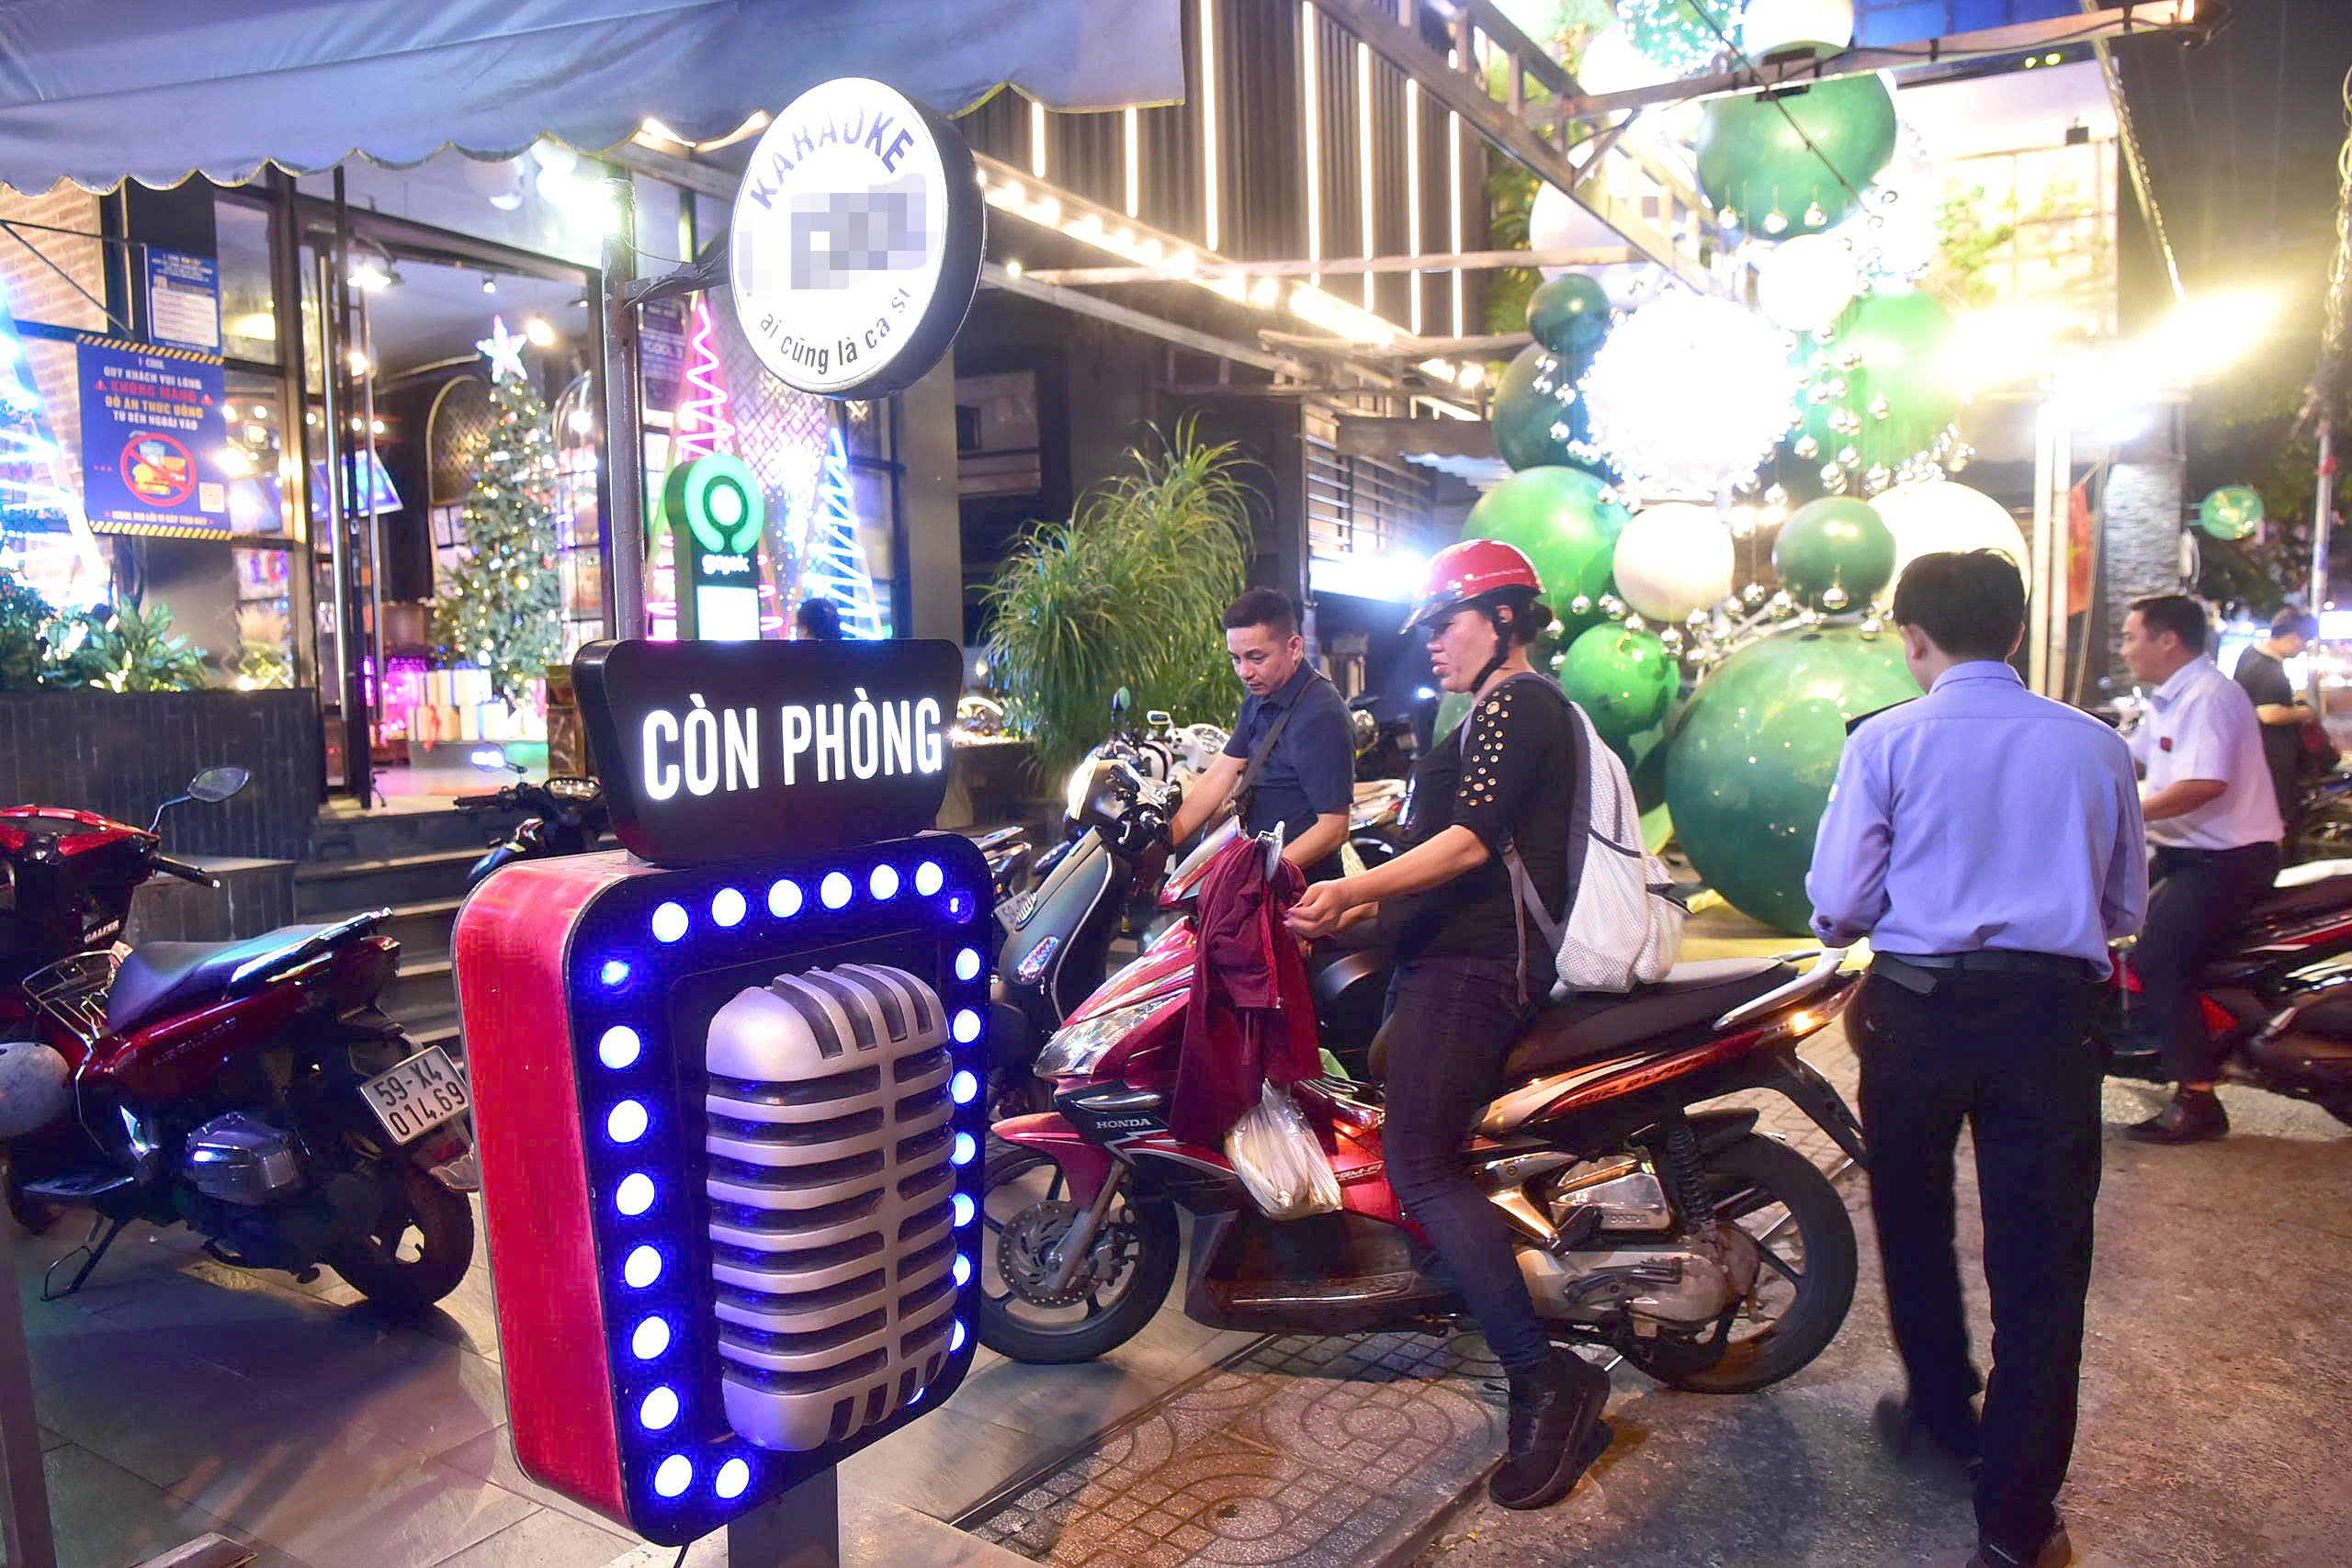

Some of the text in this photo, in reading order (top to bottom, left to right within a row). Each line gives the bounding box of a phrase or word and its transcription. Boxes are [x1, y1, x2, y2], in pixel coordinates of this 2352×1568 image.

[760, 313, 783, 339] ai
[837, 336, 858, 367] là
[865, 317, 891, 350] ca
[641, 687, 944, 801] CÒN PHÒNG
[373, 1058, 443, 1107] 59-X4
[389, 1080, 466, 1135] 014.69
[1095, 1118, 1154, 1129] HONDA
